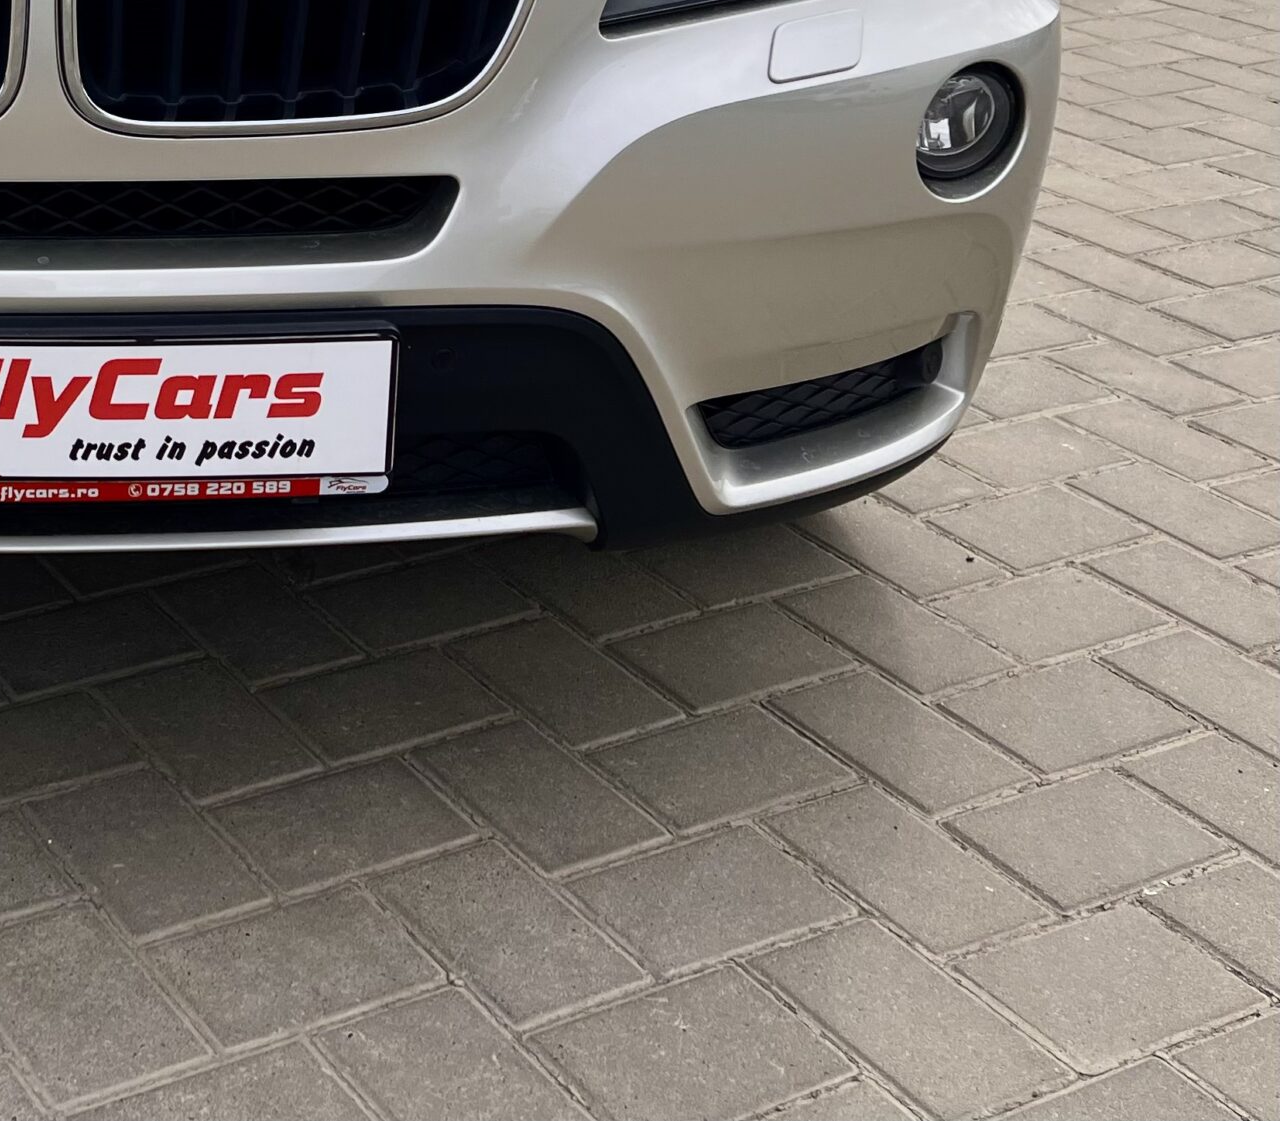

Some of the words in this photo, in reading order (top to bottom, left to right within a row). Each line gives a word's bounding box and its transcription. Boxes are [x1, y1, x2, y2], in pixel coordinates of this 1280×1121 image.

[69, 437, 146, 462] trust
[155, 435, 186, 461] in
[195, 433, 316, 467] passion
[147, 482, 200, 497] 0758
[206, 482, 245, 496] 220
[252, 480, 291, 494] 589
